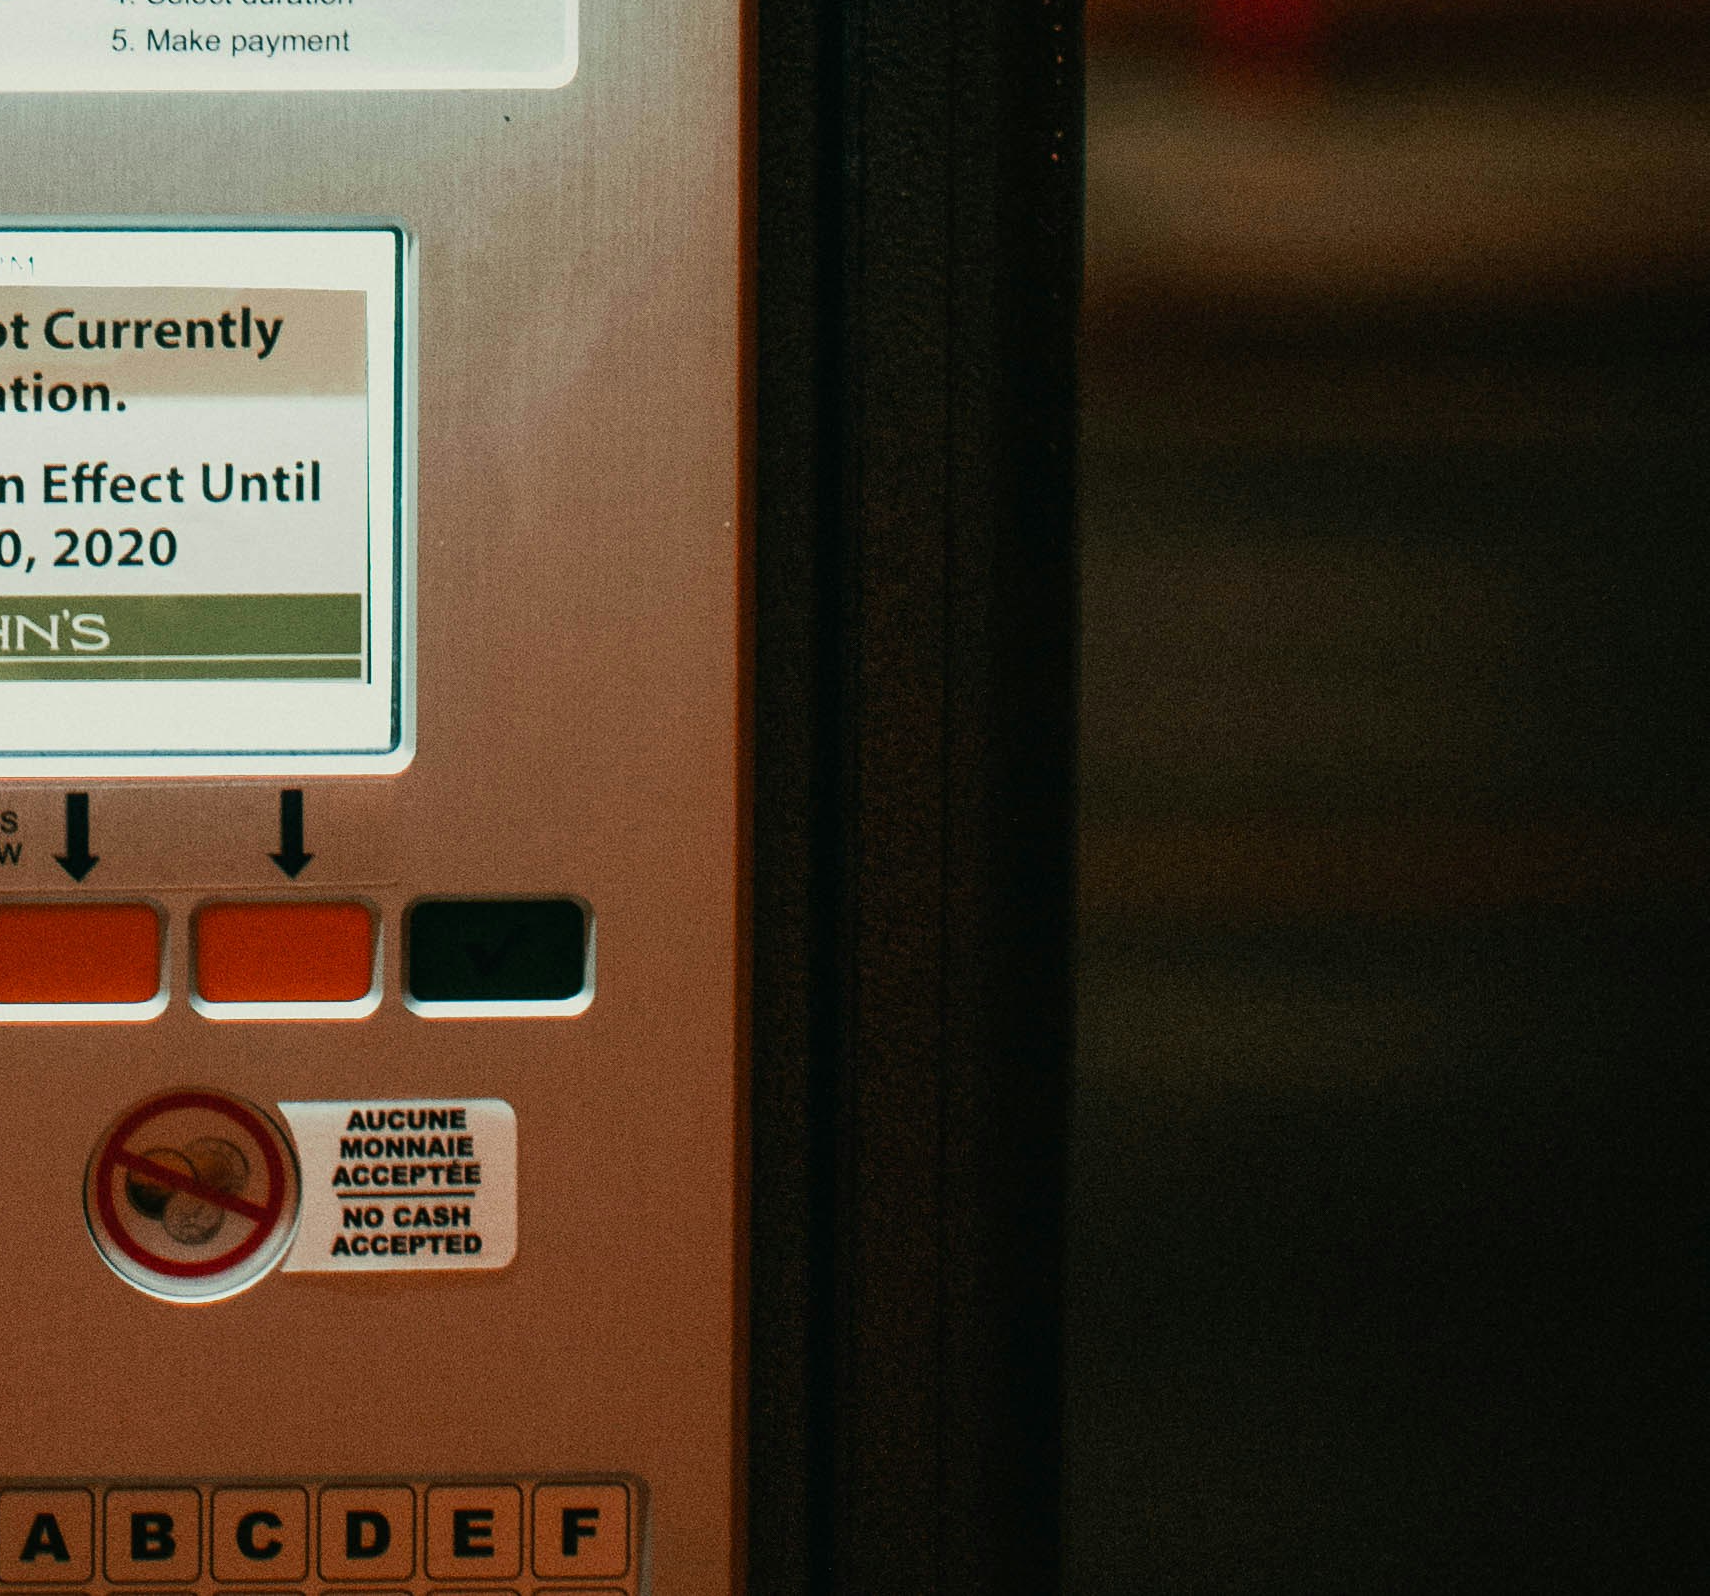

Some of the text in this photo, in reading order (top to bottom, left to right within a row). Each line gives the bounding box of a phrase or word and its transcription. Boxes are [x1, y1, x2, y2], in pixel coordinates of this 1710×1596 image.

[112, 29, 348, 56] 5. Make payment
[44, 307, 283, 359] Currently
[44, 462, 183, 502] Effect
[203, 461, 319, 502] Until
[54, 529, 176, 566] 2020
[347, 1110, 466, 1130] AUCUNE
[340, 1138, 474, 1159] MONNAIE
[332, 1162, 481, 1187] ACCEPTÉE
[344, 1206, 470, 1228] NO CASH
[331, 1235, 482, 1257] ACCEPTED
[20, 1508, 599, 1562] A B C D E F
